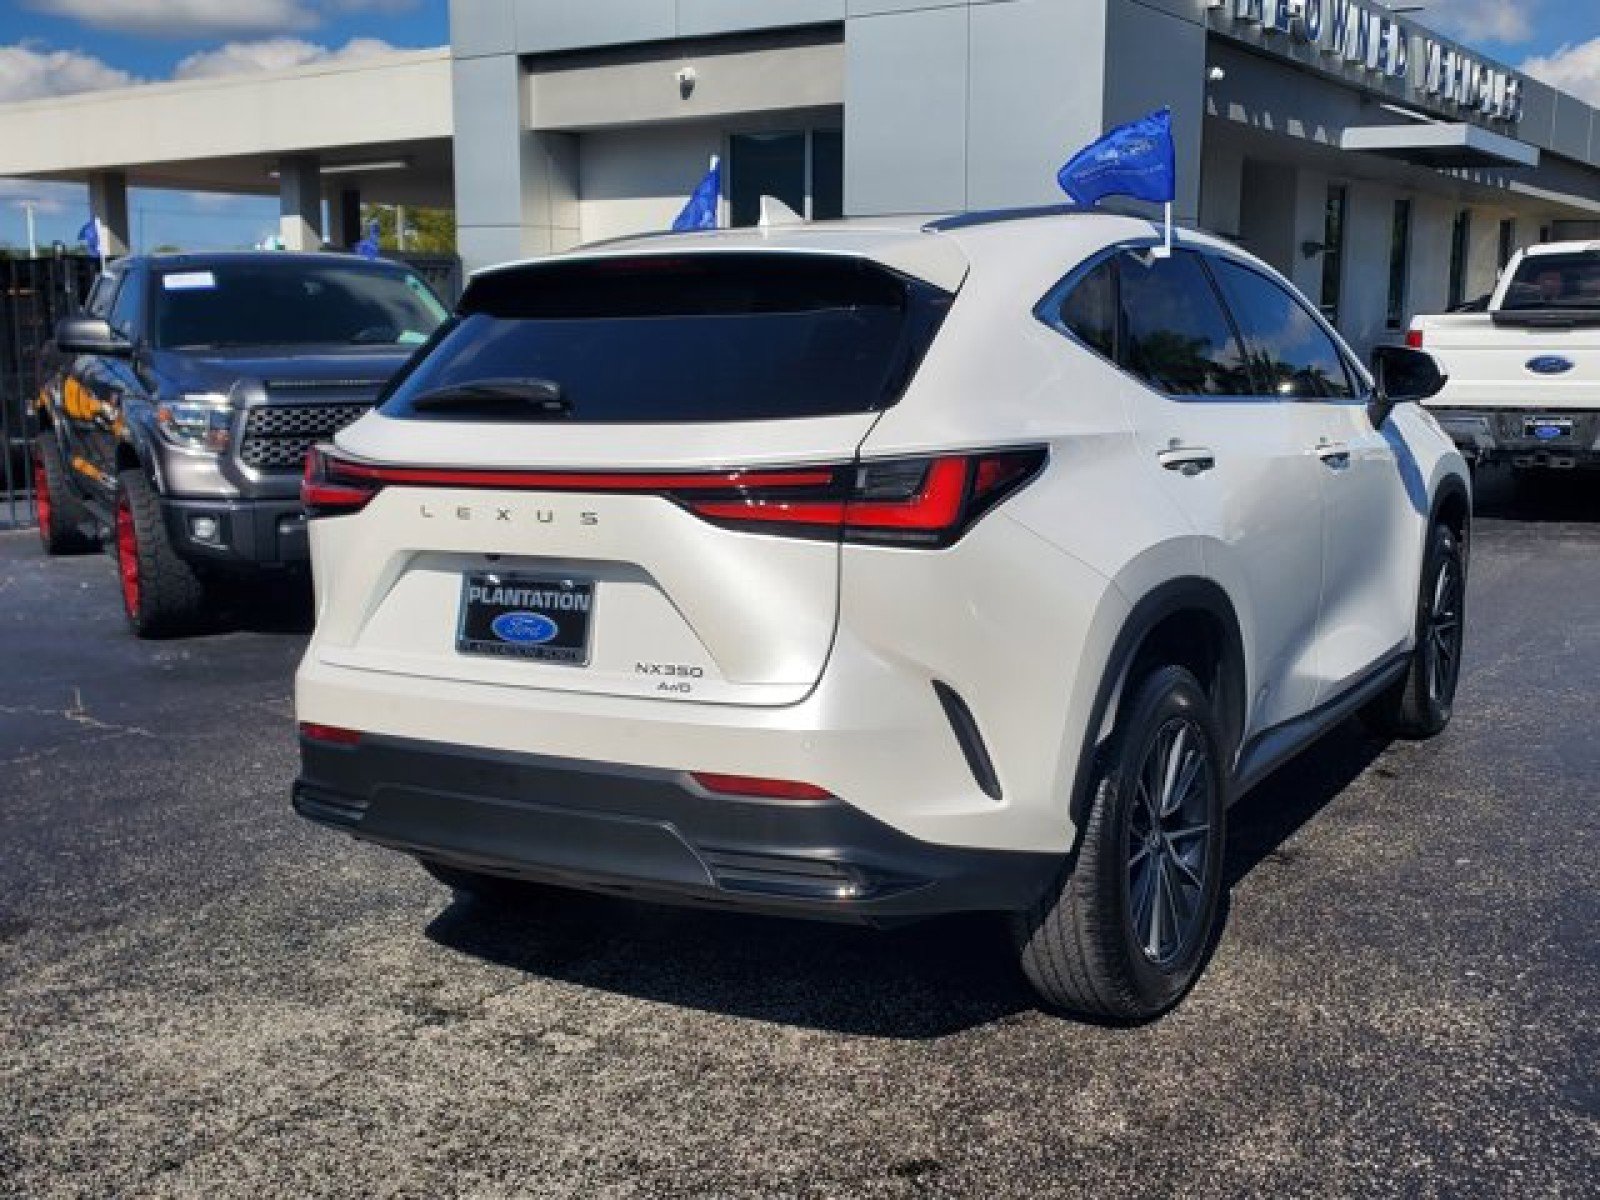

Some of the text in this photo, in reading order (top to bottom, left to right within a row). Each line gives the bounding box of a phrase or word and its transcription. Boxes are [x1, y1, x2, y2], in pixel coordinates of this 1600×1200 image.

[420, 505, 598, 526] LEXUS
[469, 587, 590, 611] PLANTATION
[635, 662, 703, 678] NX350
